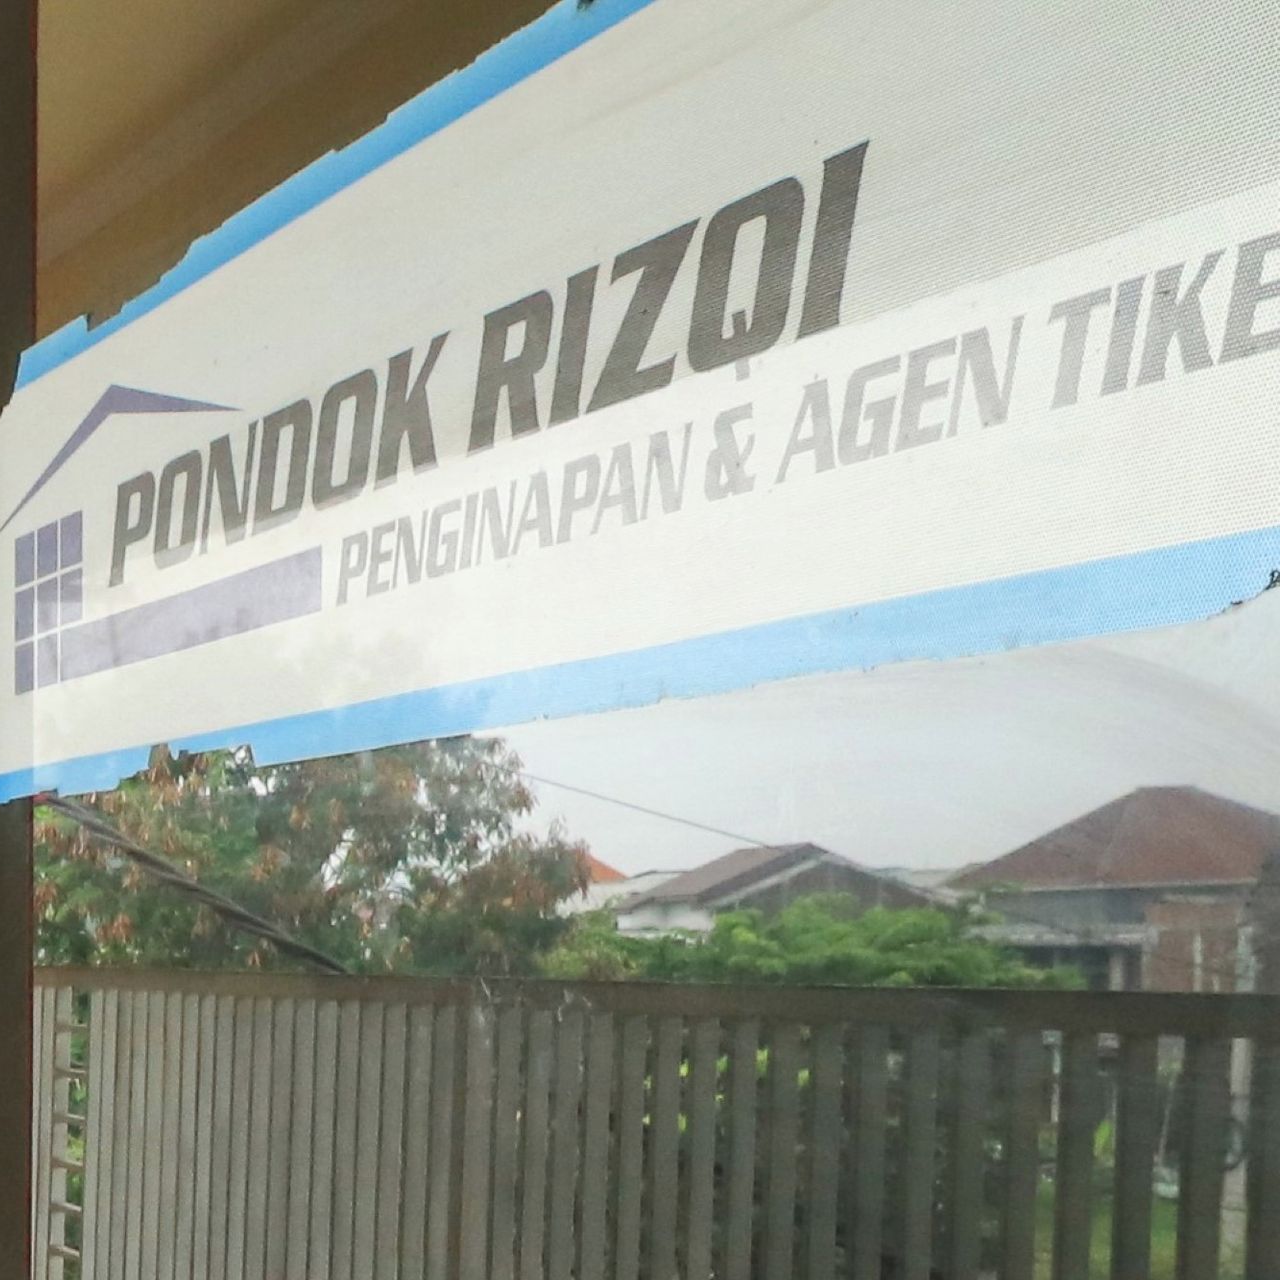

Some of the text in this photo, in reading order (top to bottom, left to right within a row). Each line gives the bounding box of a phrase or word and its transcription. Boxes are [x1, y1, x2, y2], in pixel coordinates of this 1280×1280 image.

[109, 140, 870, 587] PONDOK RIZQI
[336, 232, 1280, 606] PENGINAPAN & AGEN TIKE
